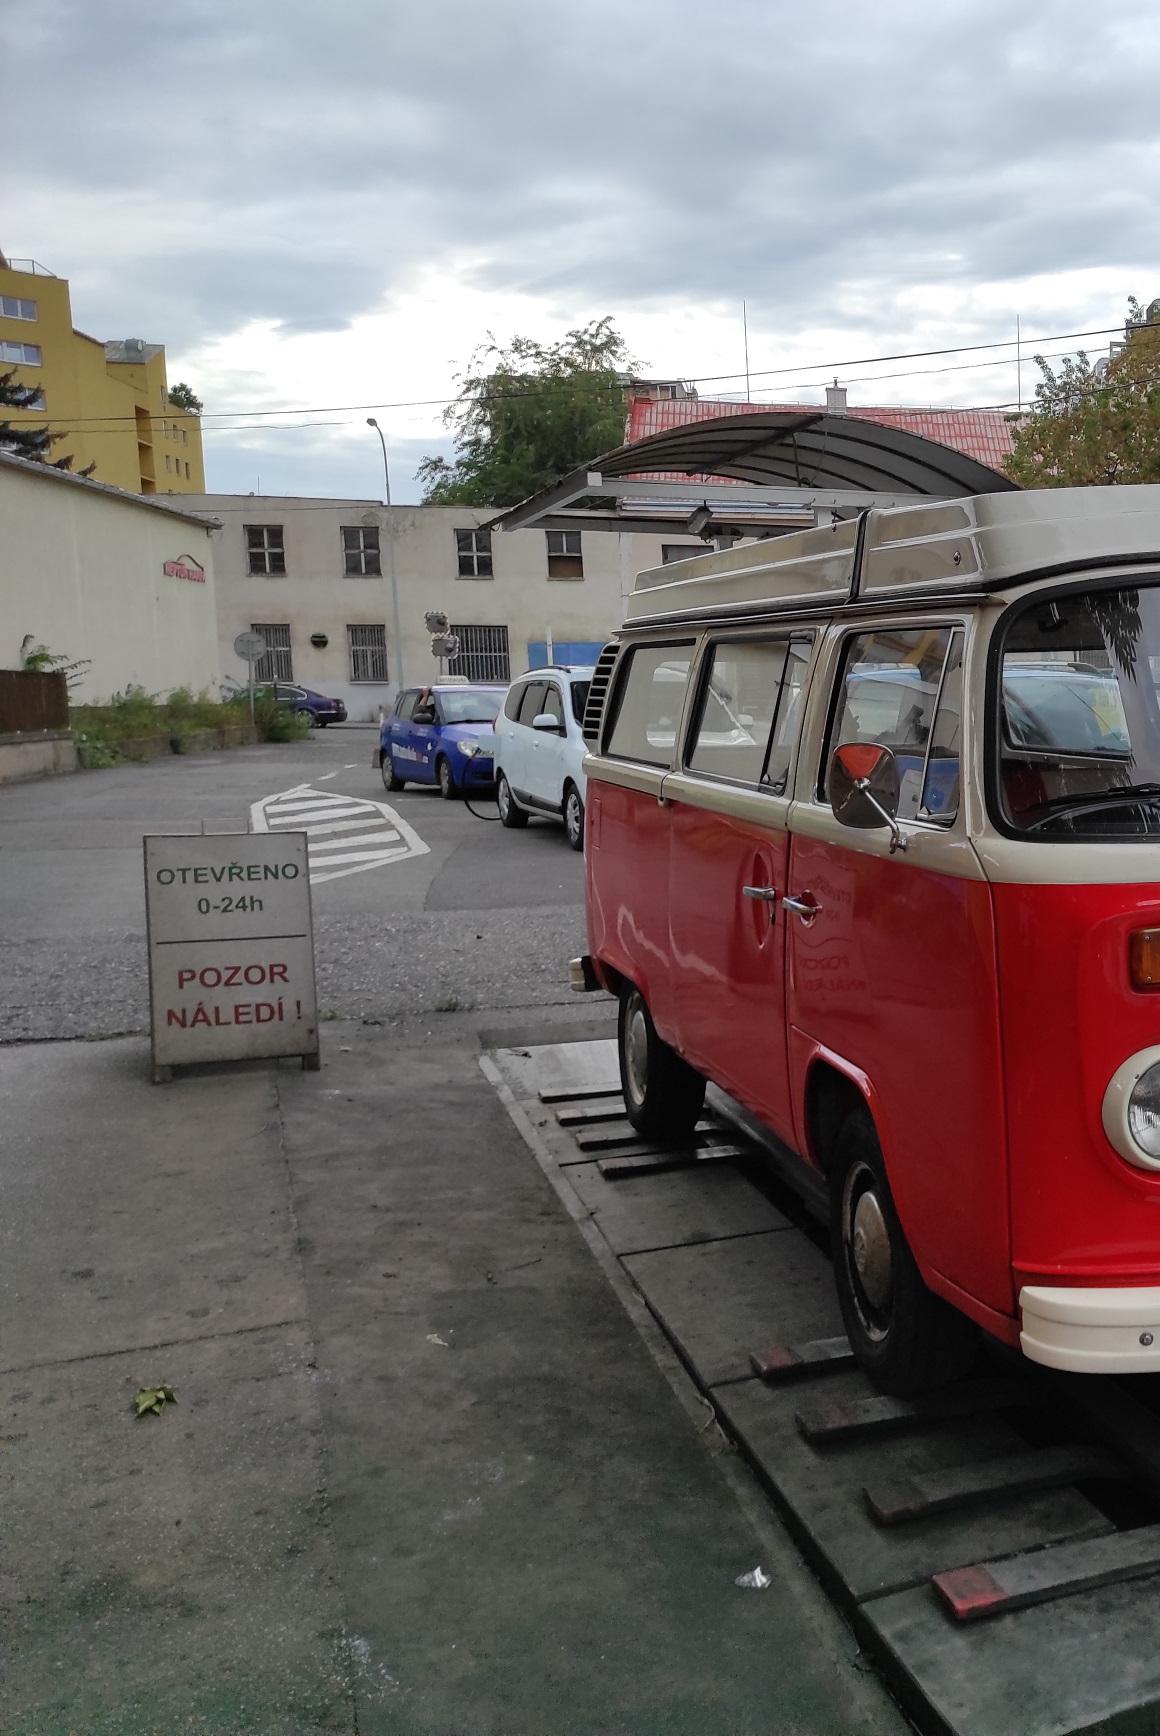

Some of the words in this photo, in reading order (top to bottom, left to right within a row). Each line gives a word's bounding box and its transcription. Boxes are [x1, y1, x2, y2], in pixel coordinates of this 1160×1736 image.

[156, 862, 299, 886] OTEVŘENO
[197, 896, 264, 915] 0-24h
[177, 963, 290, 990] POZOR
[166, 997, 284, 1029] NÁLEDÍ
